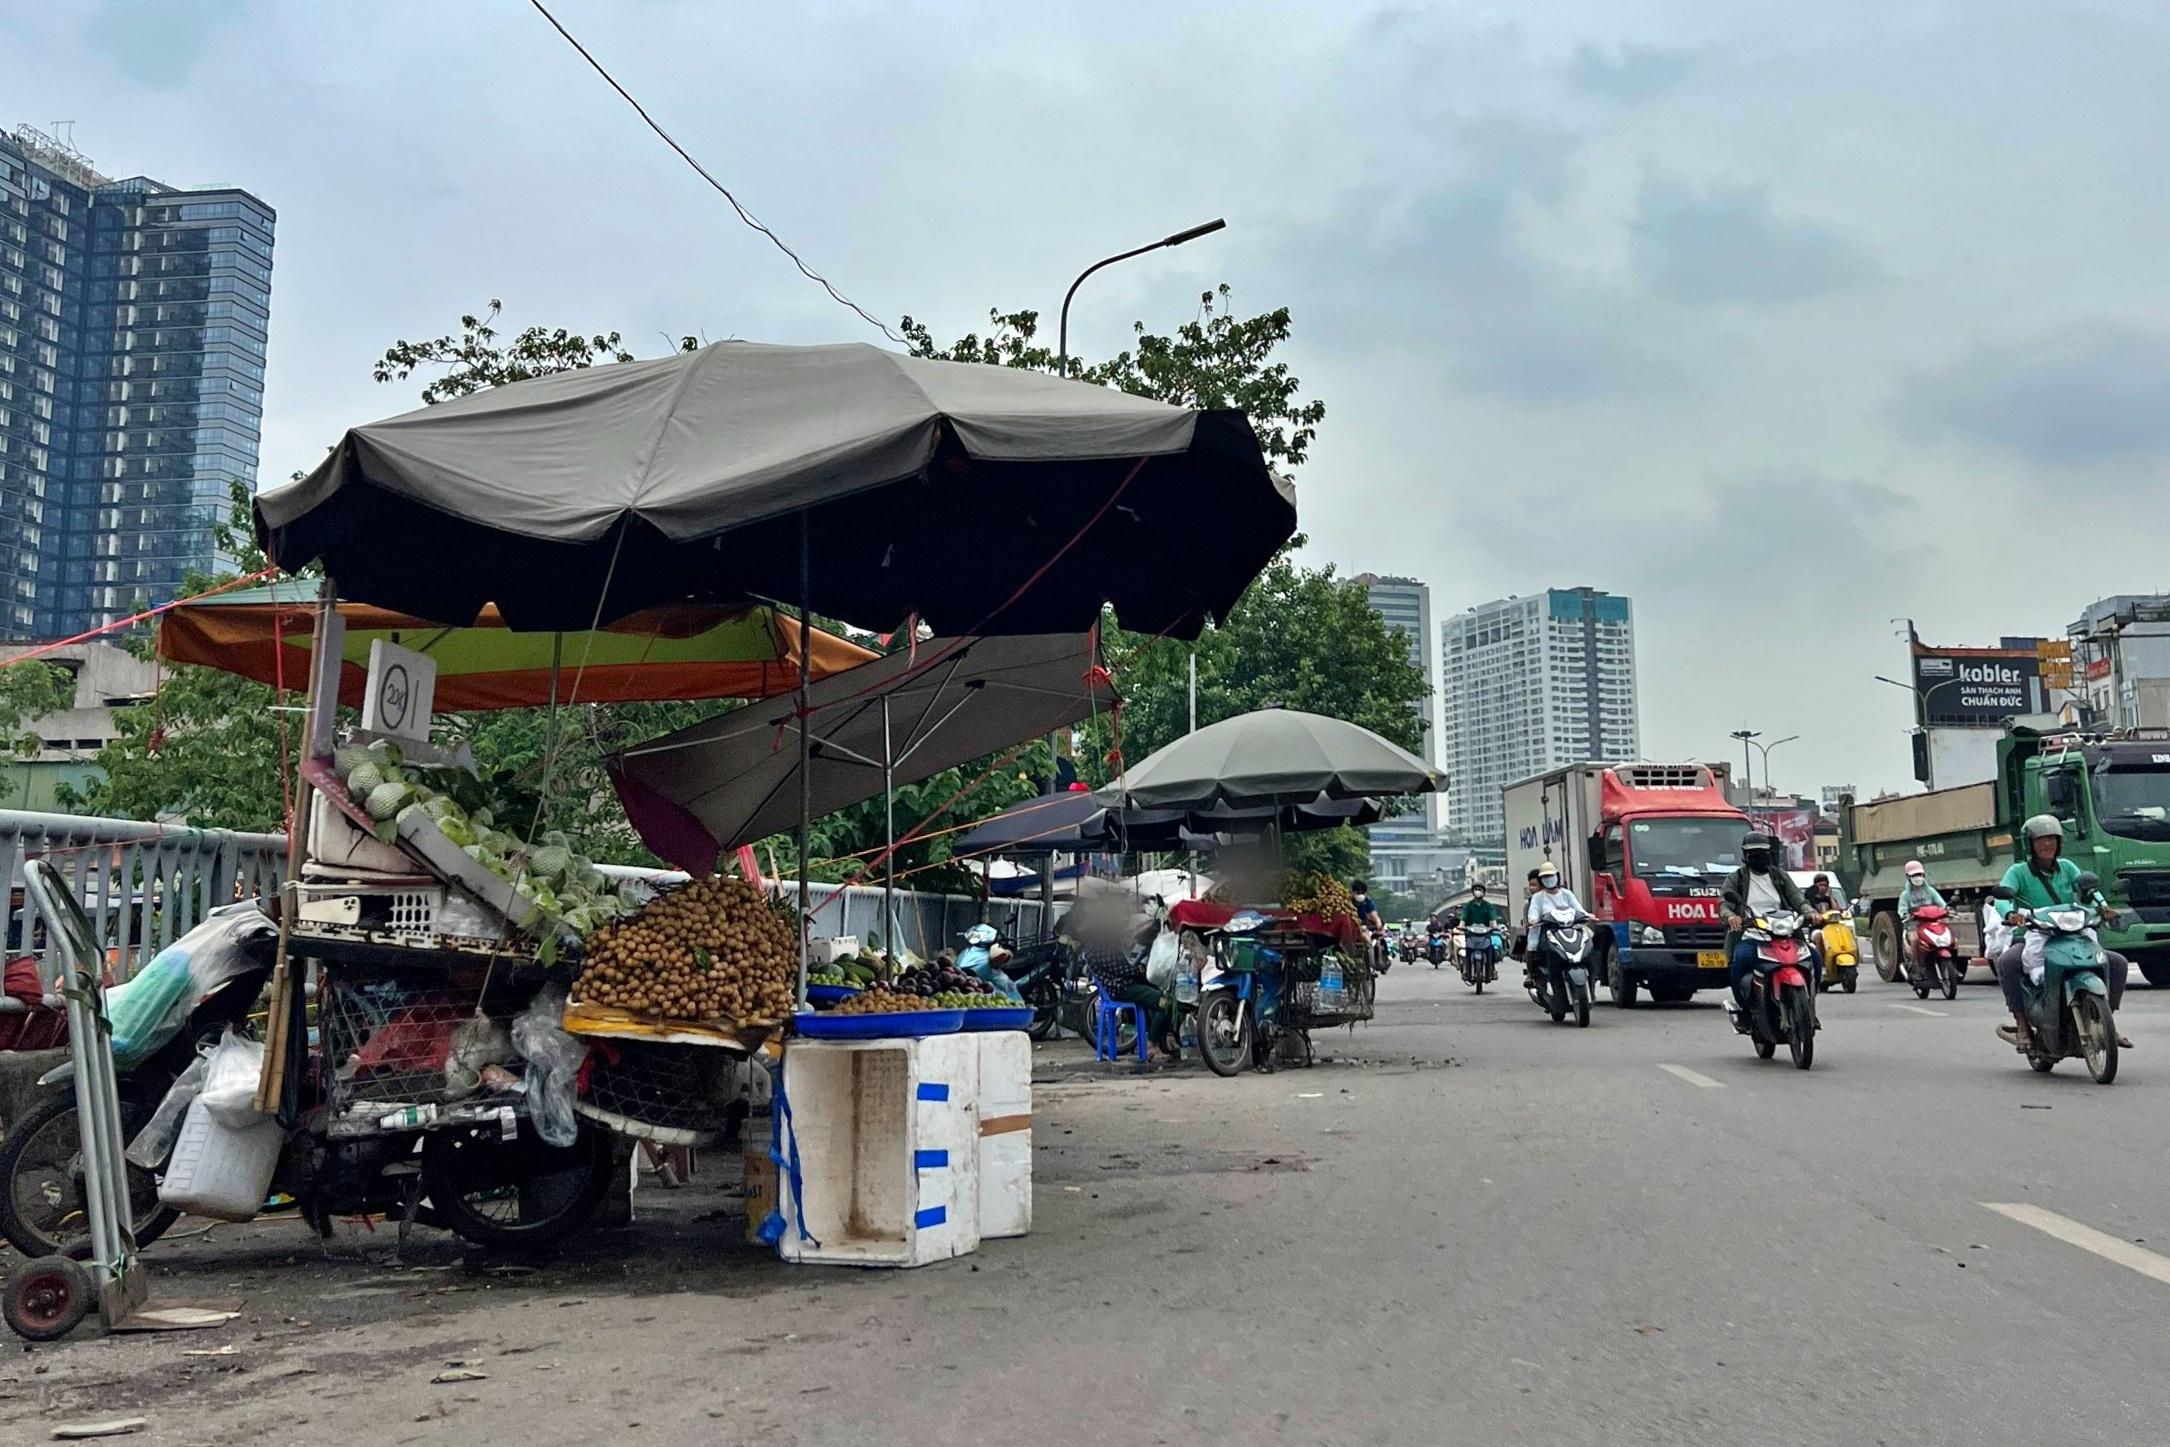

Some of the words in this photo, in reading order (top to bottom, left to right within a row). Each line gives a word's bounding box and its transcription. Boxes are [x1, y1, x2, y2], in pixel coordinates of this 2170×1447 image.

[2005, 687, 2022, 695] ANH
[2139, 730, 2168, 740] HOWO
[1668, 903, 1706, 919] HOA
